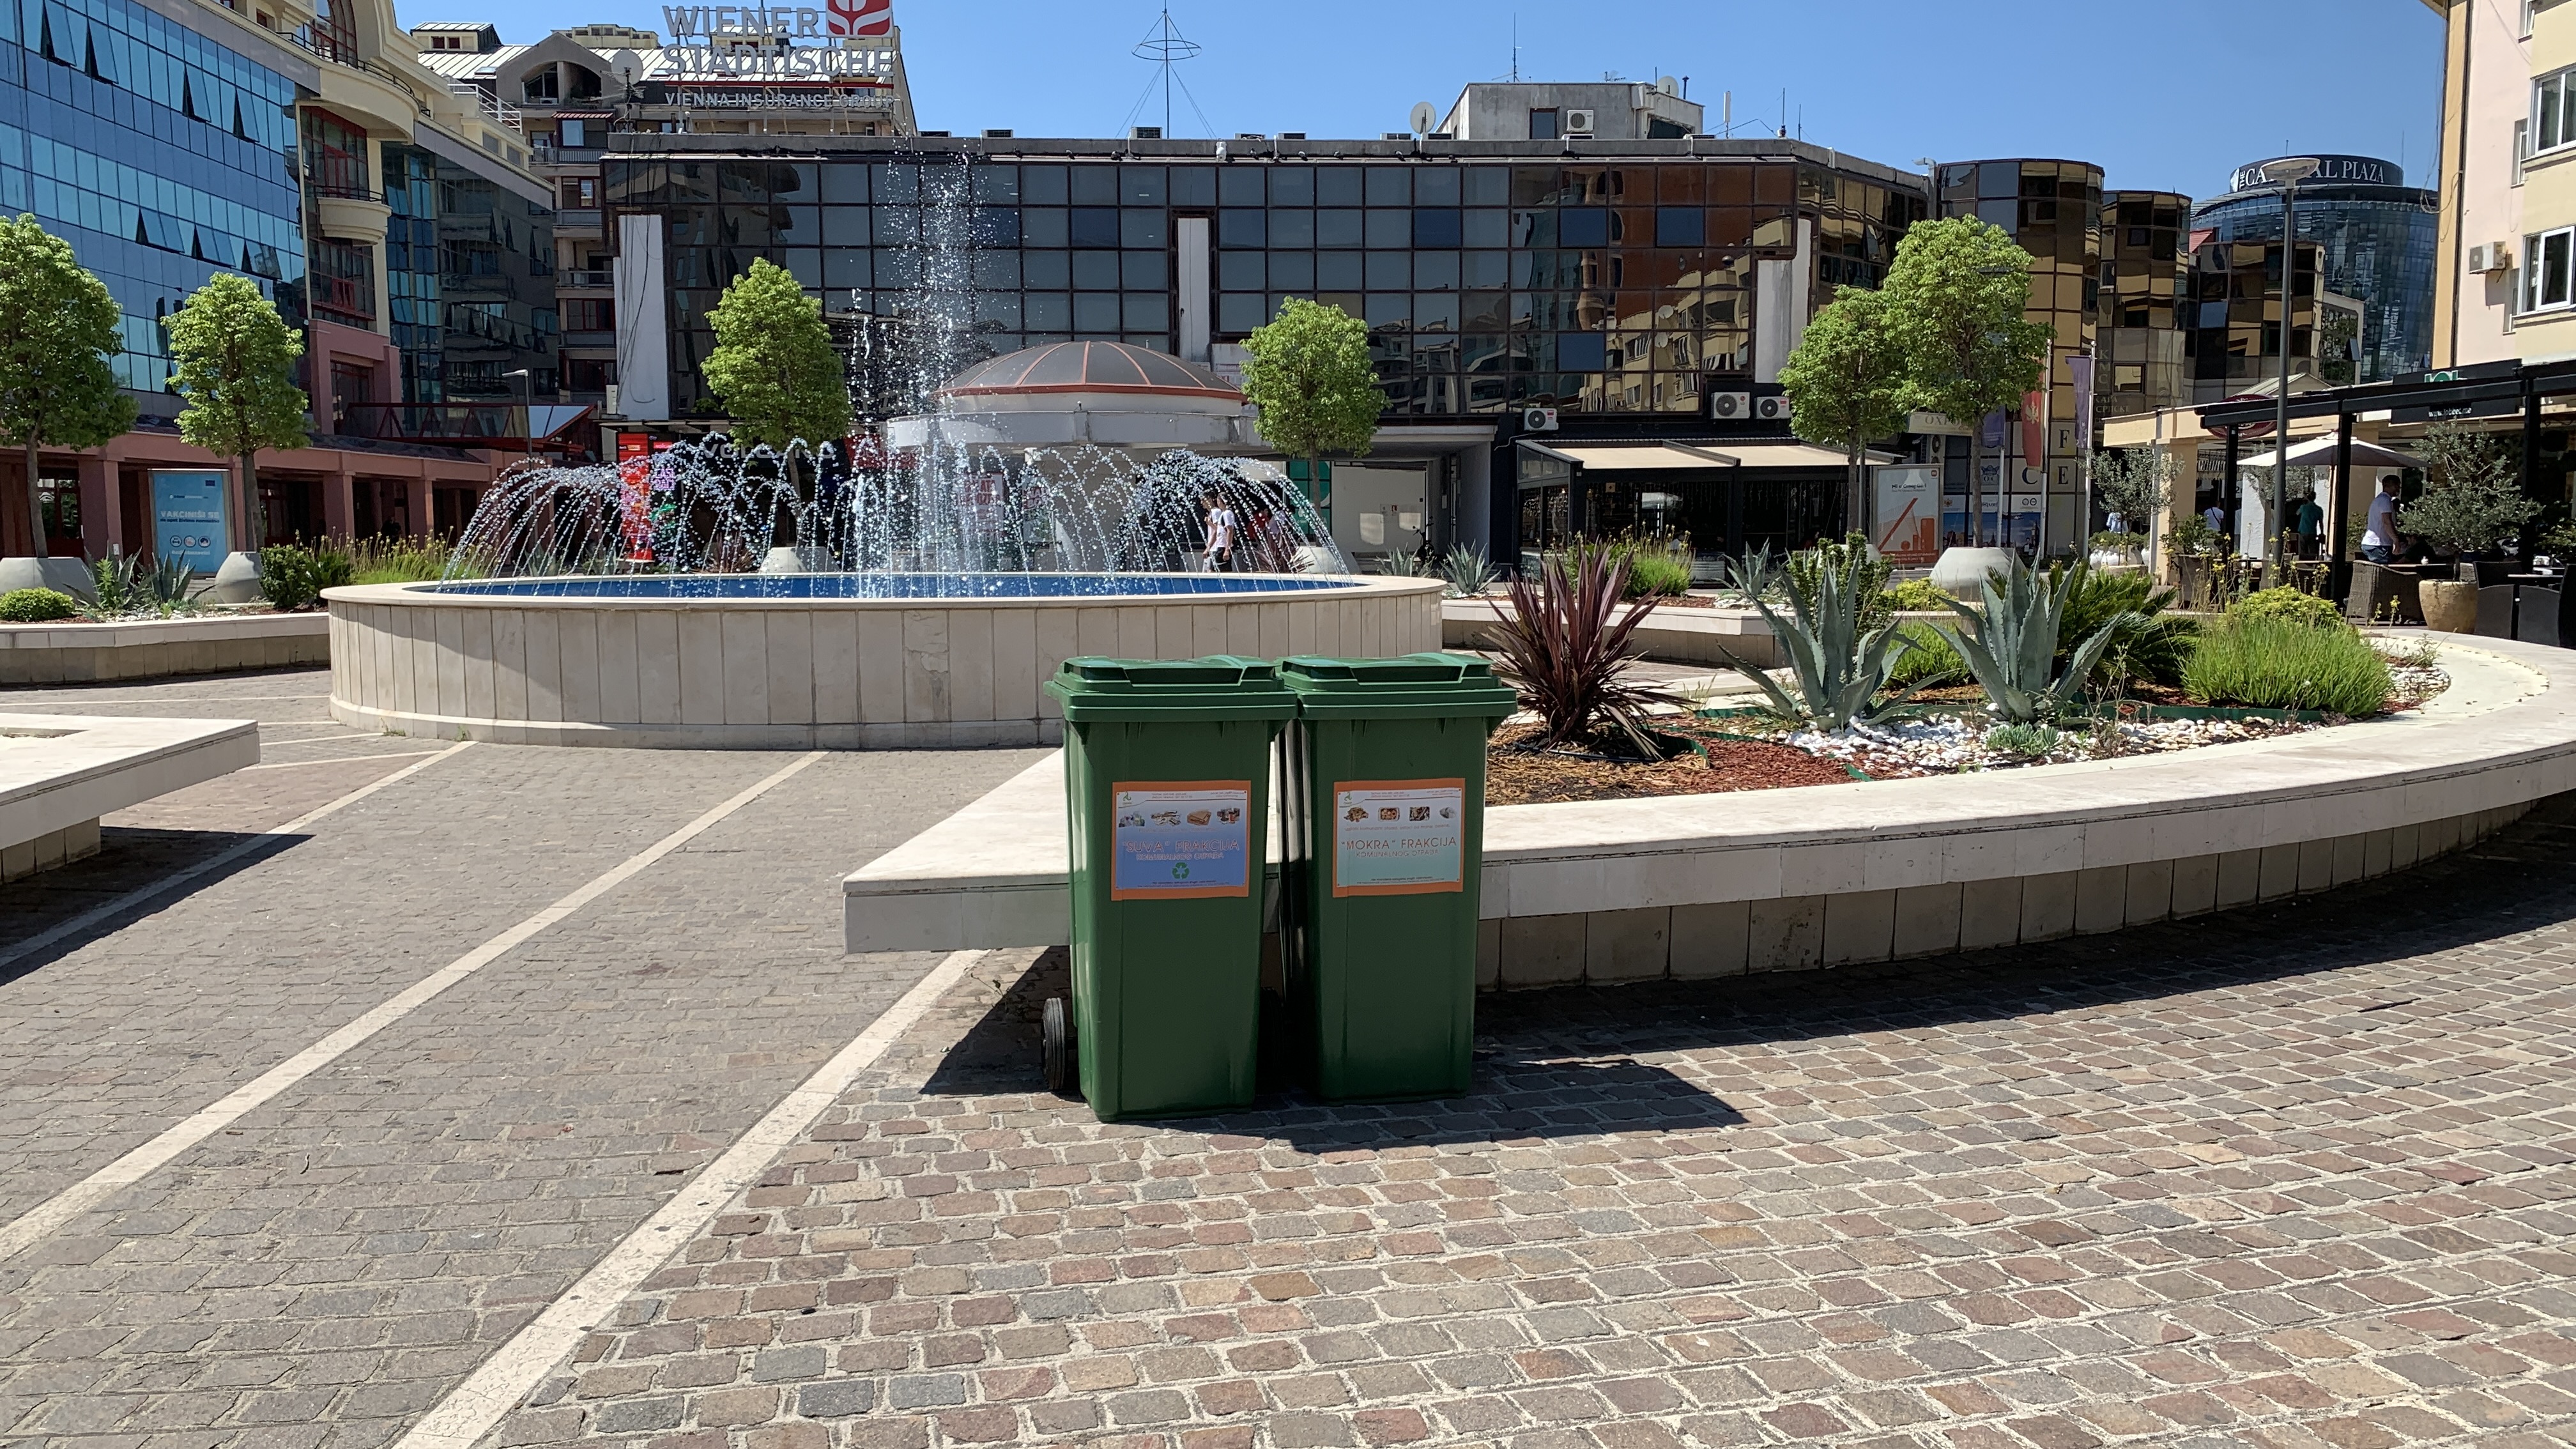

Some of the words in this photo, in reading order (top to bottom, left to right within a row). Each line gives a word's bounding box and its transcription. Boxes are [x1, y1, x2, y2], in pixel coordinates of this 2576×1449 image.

[663, 6, 819, 38] WIENER
[663, 43, 894, 77] STÄDTISCHE
[664, 93, 730, 107] VIENNA
[735, 93, 832, 107] INSURANCE
[839, 94, 894, 109] GROUP
[2245, 160, 2338, 187] CAAL
[2342, 160, 2385, 183] PLAZA
[1176, 838, 1240, 852] FRAKCIJA
[1401, 836, 1457, 848] FRAKCIJA
